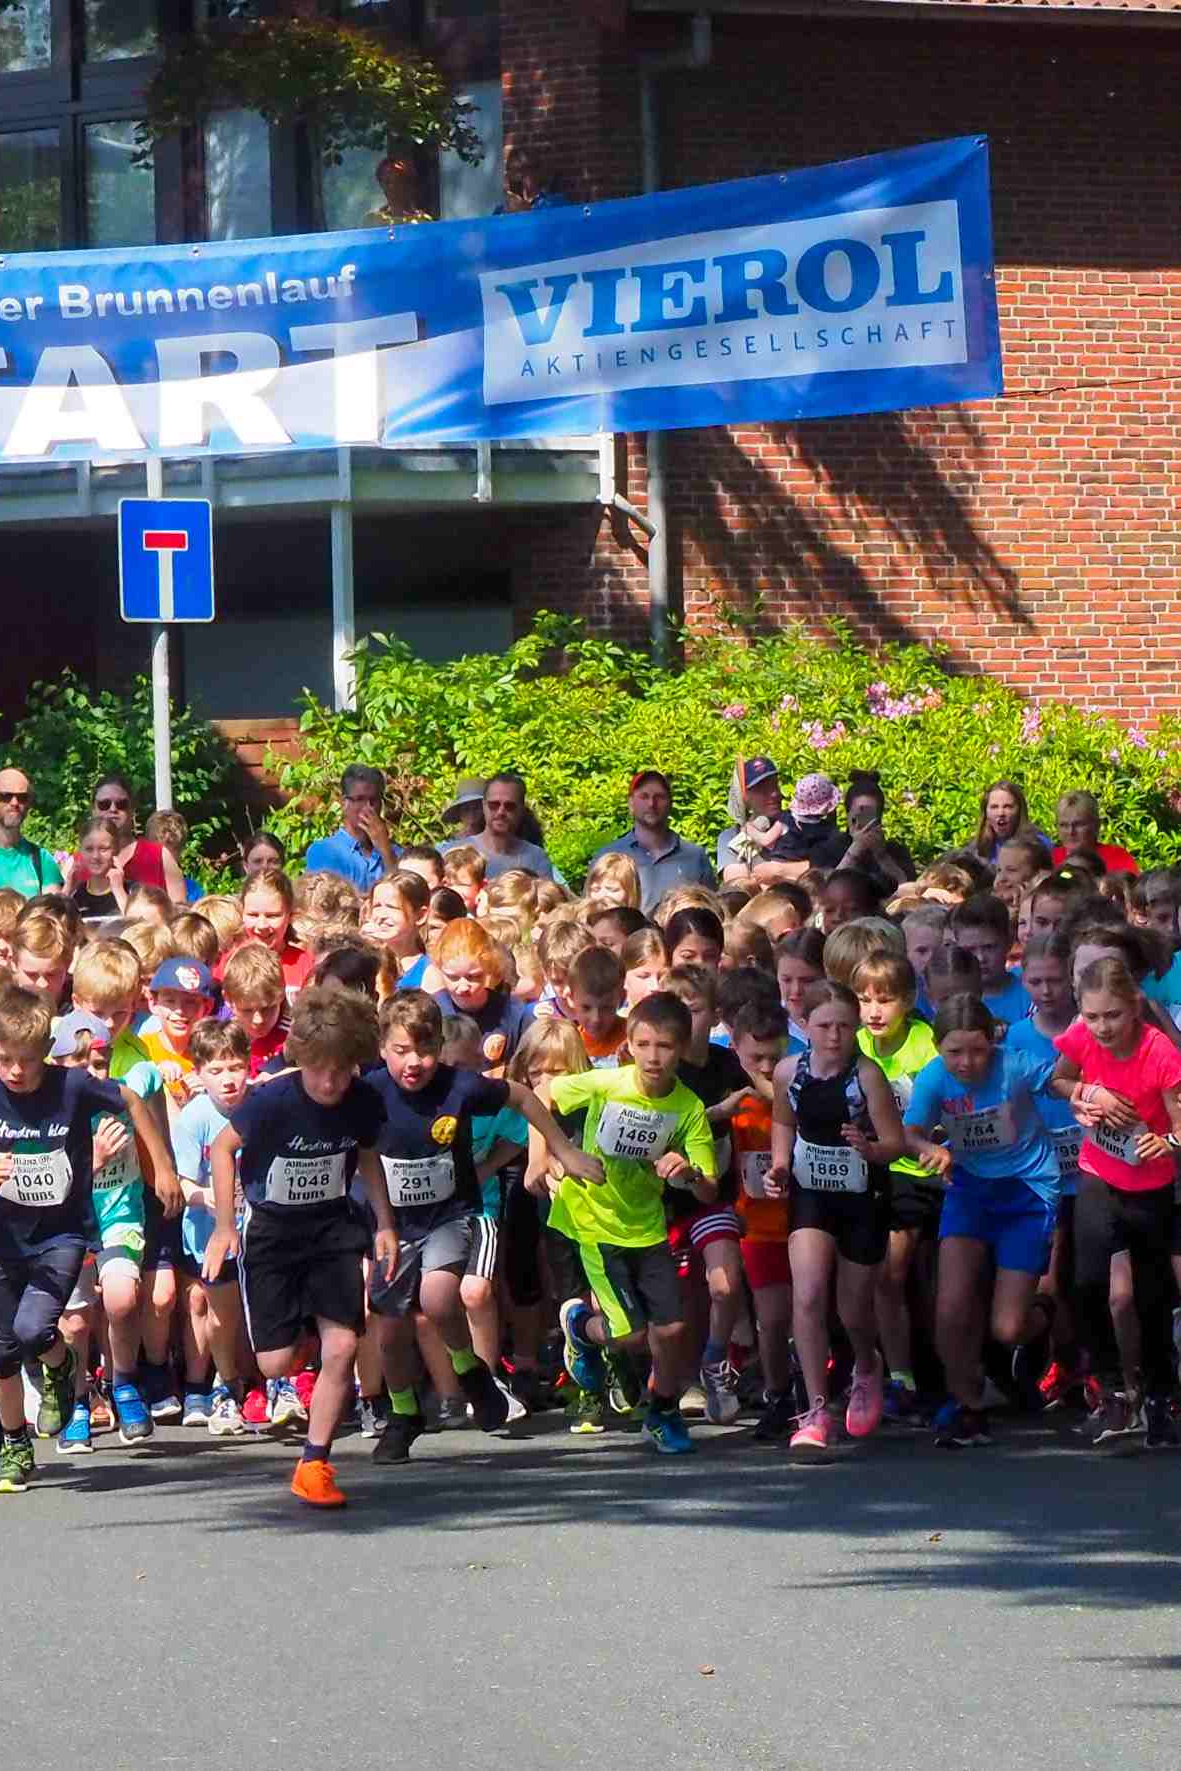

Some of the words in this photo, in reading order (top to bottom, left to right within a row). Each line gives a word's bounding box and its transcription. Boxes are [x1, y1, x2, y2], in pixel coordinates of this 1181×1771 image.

[59, 264, 356, 318] Brunnenlauf
[495, 231, 954, 346] VIEROL
[520, 319, 957, 377] AKTIENGESELLSCHAFT
[618, 1125, 658, 1144] 1469
[614, 1140, 651, 1157] bruns
[1096, 1132, 1126, 1157] bruns
[808, 1162, 849, 1177] 1889
[13, 1173, 54, 1187] 1040
[286, 1174, 330, 1188] 1048
[400, 1175, 431, 1189] 291
[811, 1174, 847, 1189] bruns
[18, 1189, 55, 1201] bruns
[288, 1189, 326, 1201] bruns
[399, 1190, 436, 1202] bruns
